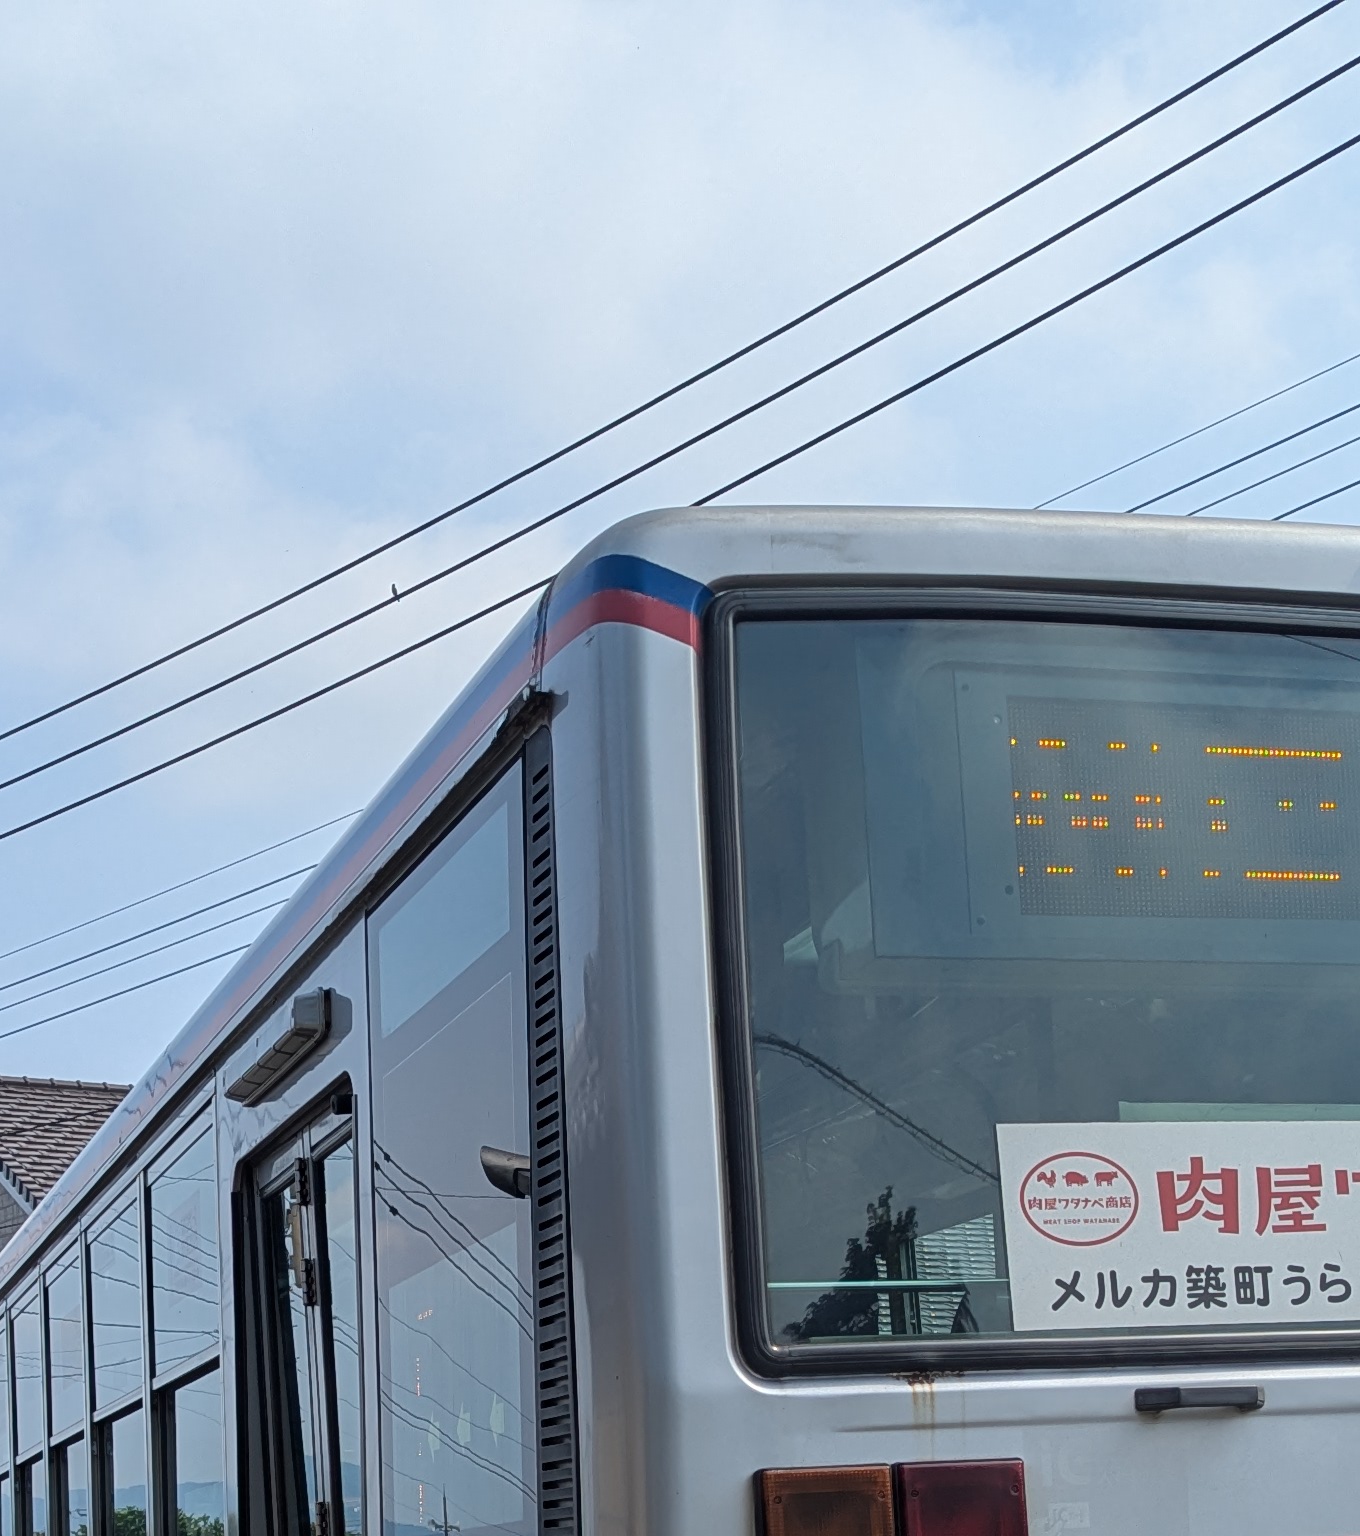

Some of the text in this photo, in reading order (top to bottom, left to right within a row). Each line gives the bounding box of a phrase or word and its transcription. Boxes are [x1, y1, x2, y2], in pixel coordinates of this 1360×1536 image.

[1051, 1262, 1353, 1312] メルカ築町うら
